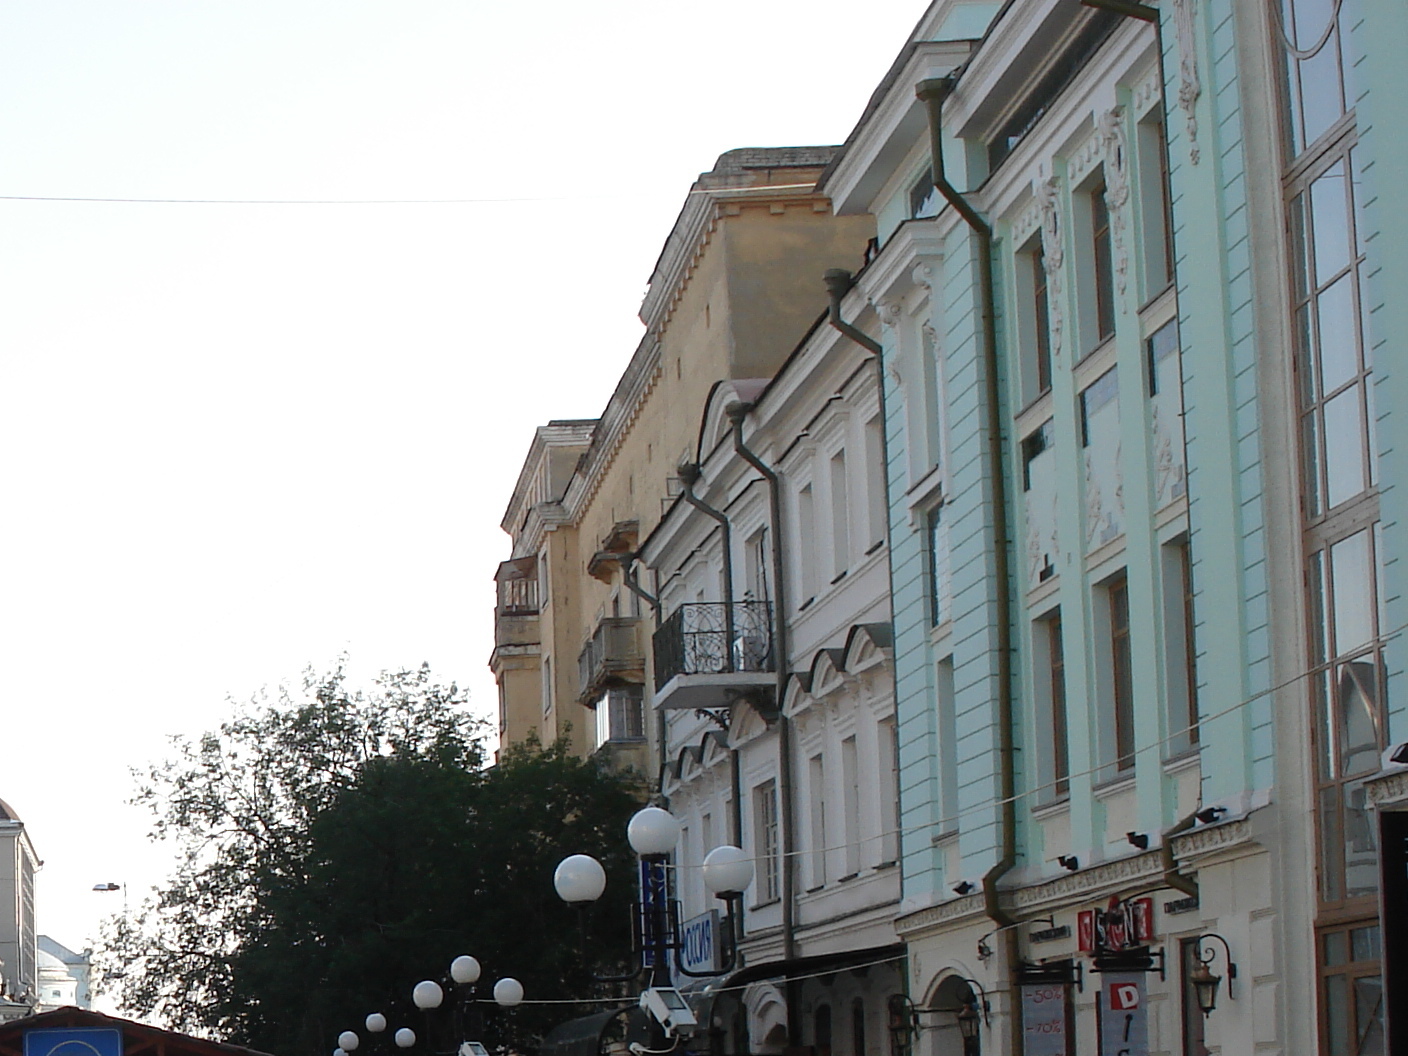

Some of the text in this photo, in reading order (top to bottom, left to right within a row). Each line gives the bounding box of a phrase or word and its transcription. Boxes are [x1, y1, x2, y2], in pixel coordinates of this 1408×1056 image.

[682, 919, 712, 967] ОССИЯ
[1025, 986, 1062, 1004] -50%
[1026, 1019, 1061, 1034] -70%
